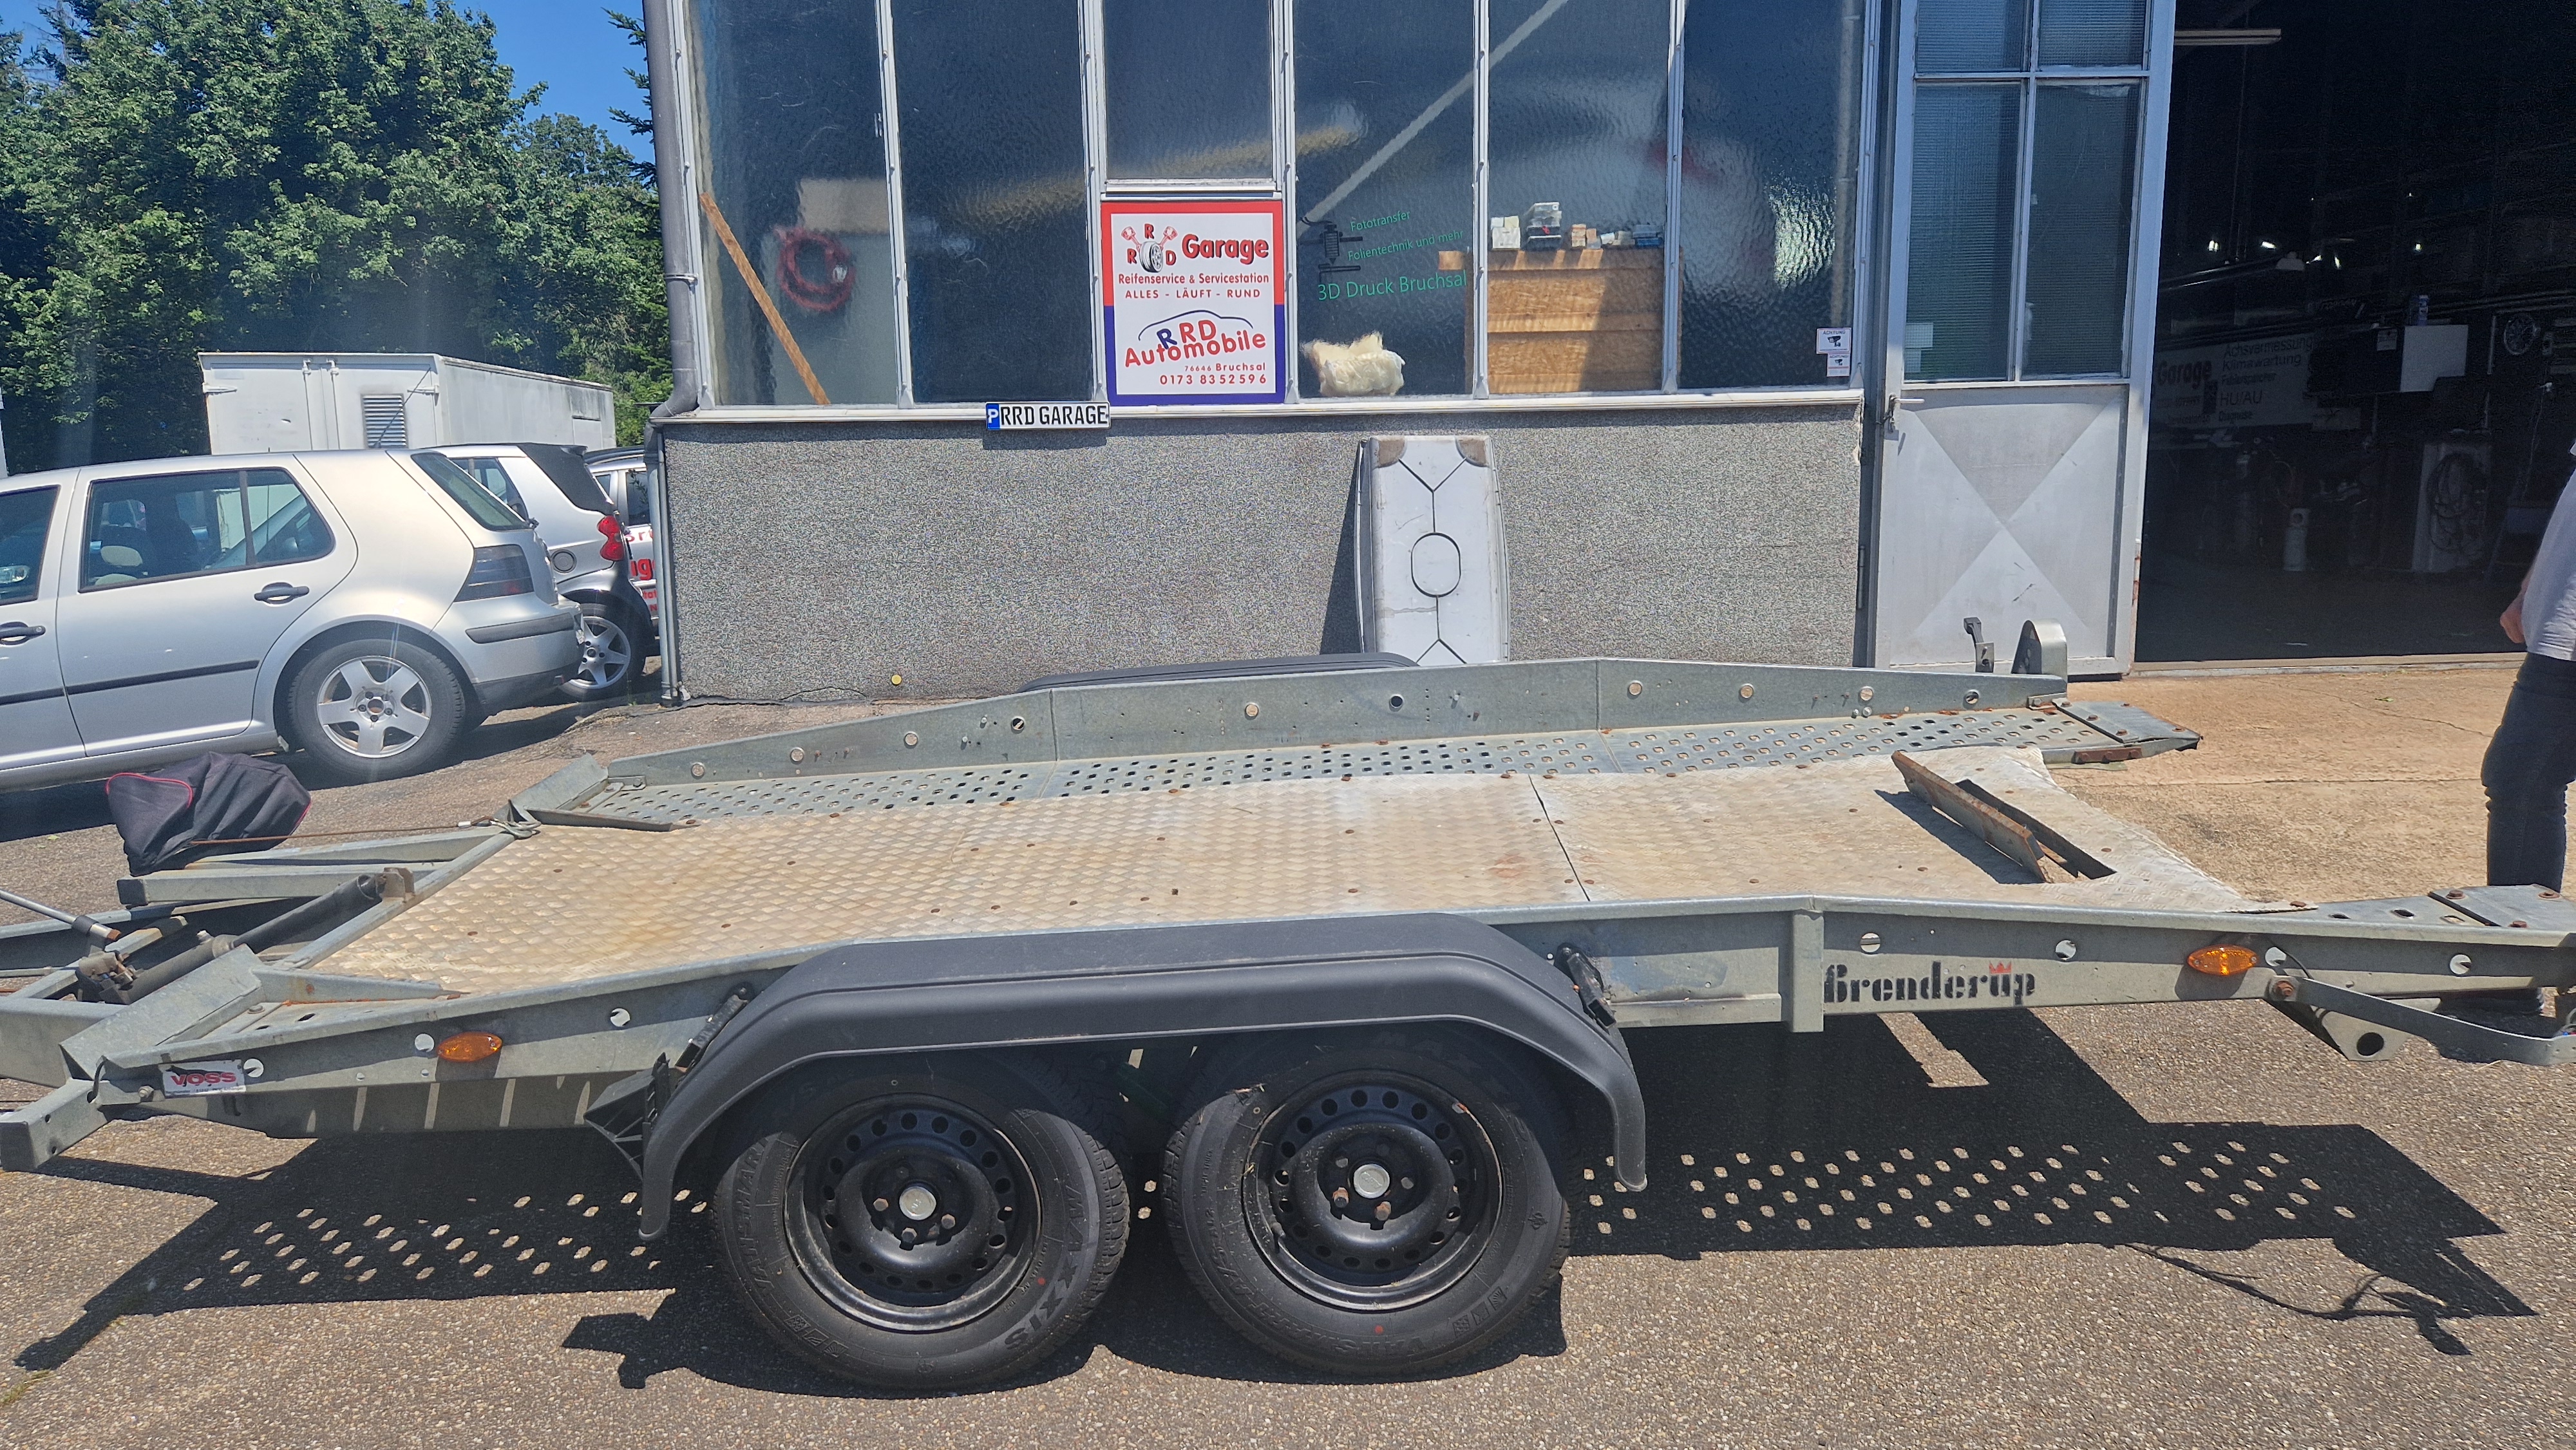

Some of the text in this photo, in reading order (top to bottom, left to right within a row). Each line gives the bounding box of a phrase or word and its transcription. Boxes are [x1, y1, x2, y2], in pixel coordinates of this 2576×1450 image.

[1350, 210, 1411, 232] Fototransfer
[1182, 234, 1269, 265] Garage
[1347, 230, 1464, 261] Folientechnik und mehr
[1118, 272, 1269, 284] Reifenservice & Servicestation
[1318, 269, 1467, 301] 3D Druck Bruchsal
[1125, 290, 1159, 299] ALLES
[1177, 287, 1212, 298] LÄUFT
[1227, 289, 1260, 297] RUND
[1125, 330, 1266, 367] Automobile
[1215, 363, 1266, 372] Bruchsal
[2157, 361, 2212, 389] Garage
[1160, 375, 1193, 385] 0173
[2220, 390, 2263, 406] HU/AU
[1000, 406, 1035, 425] RRD
[1039, 405, 1108, 425] GARAGE
[1824, 960, 2036, 1006] Brenderup
[171, 1072, 236, 1086] VOSS
[1004, 1184, 1086, 1351] MAXXIS
